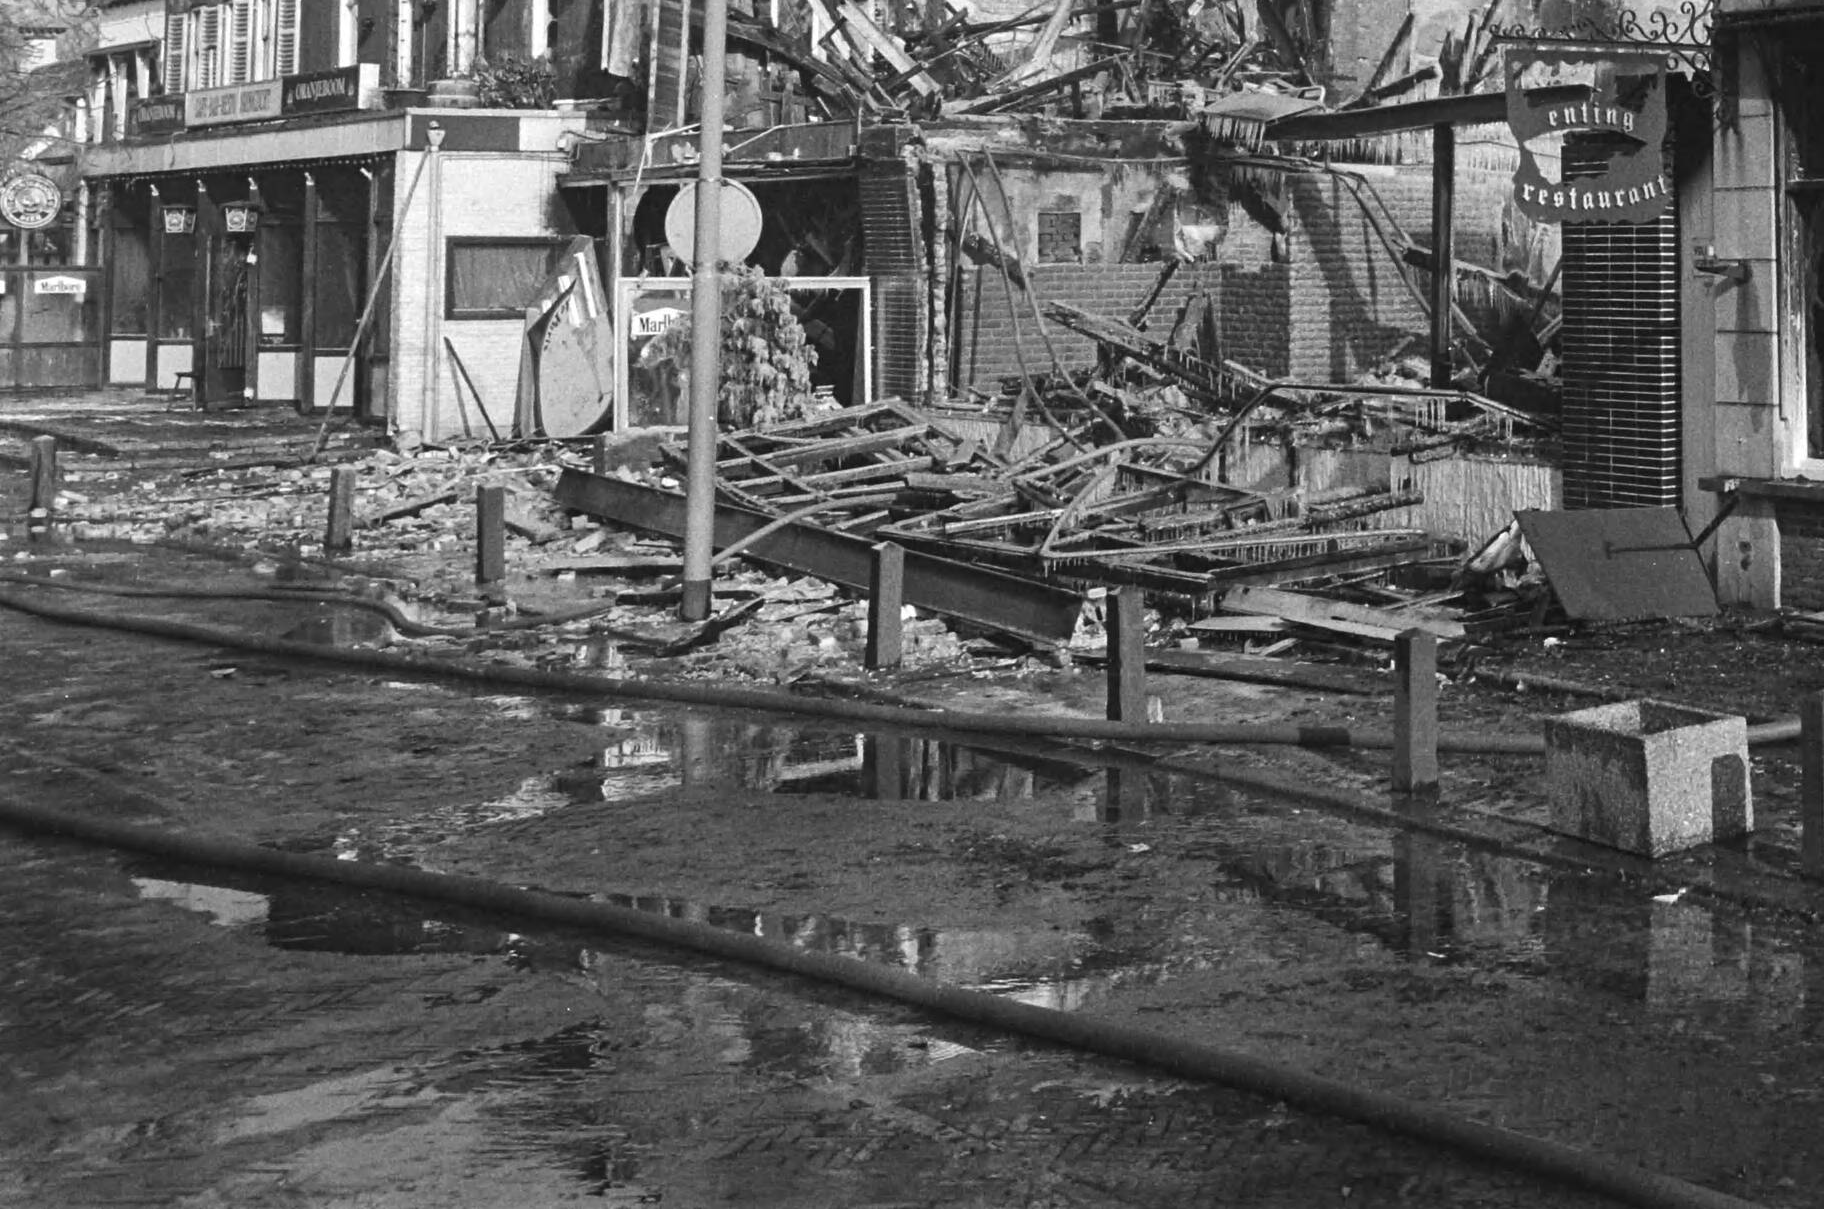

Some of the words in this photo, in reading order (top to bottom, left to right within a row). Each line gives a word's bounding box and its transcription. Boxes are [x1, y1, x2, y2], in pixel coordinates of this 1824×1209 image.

[295, 77, 346, 101] ORANJEBOOM
[1549, 102, 1634, 132] enting
[1522, 174, 1669, 210] restaurant
